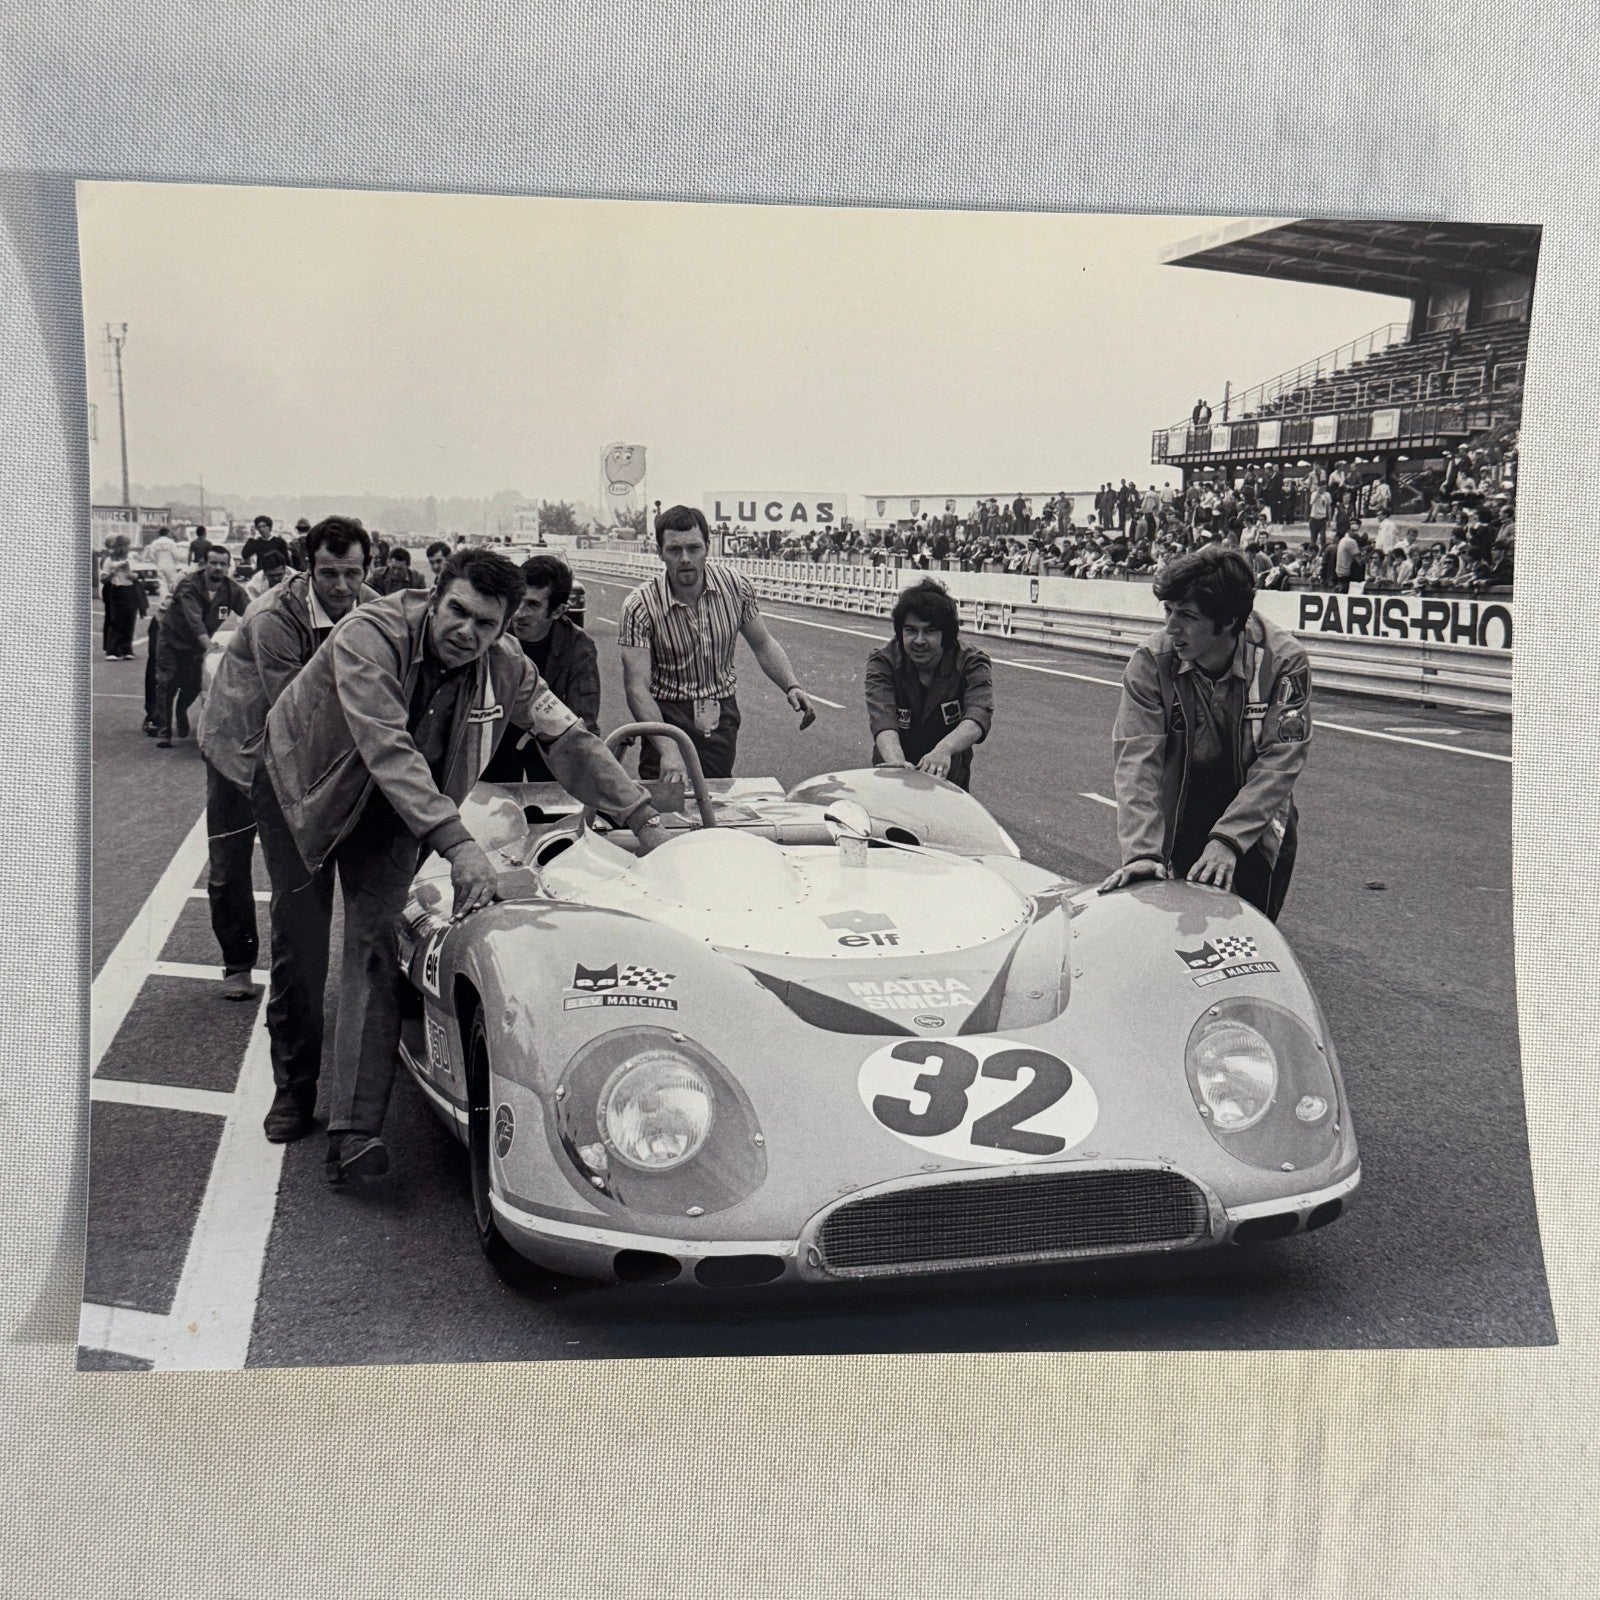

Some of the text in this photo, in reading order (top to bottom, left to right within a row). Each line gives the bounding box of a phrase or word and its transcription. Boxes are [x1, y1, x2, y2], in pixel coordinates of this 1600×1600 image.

[714, 500, 835, 523] LUCAS
[837, 933, 900, 947] elf
[1225, 962, 1277, 977] MARCHAL
[847, 977, 972, 996] MATRA
[607, 995, 675, 1009] MARCHAL
[862, 992, 977, 1010] SIMCA
[872, 1040, 1073, 1156] 32
